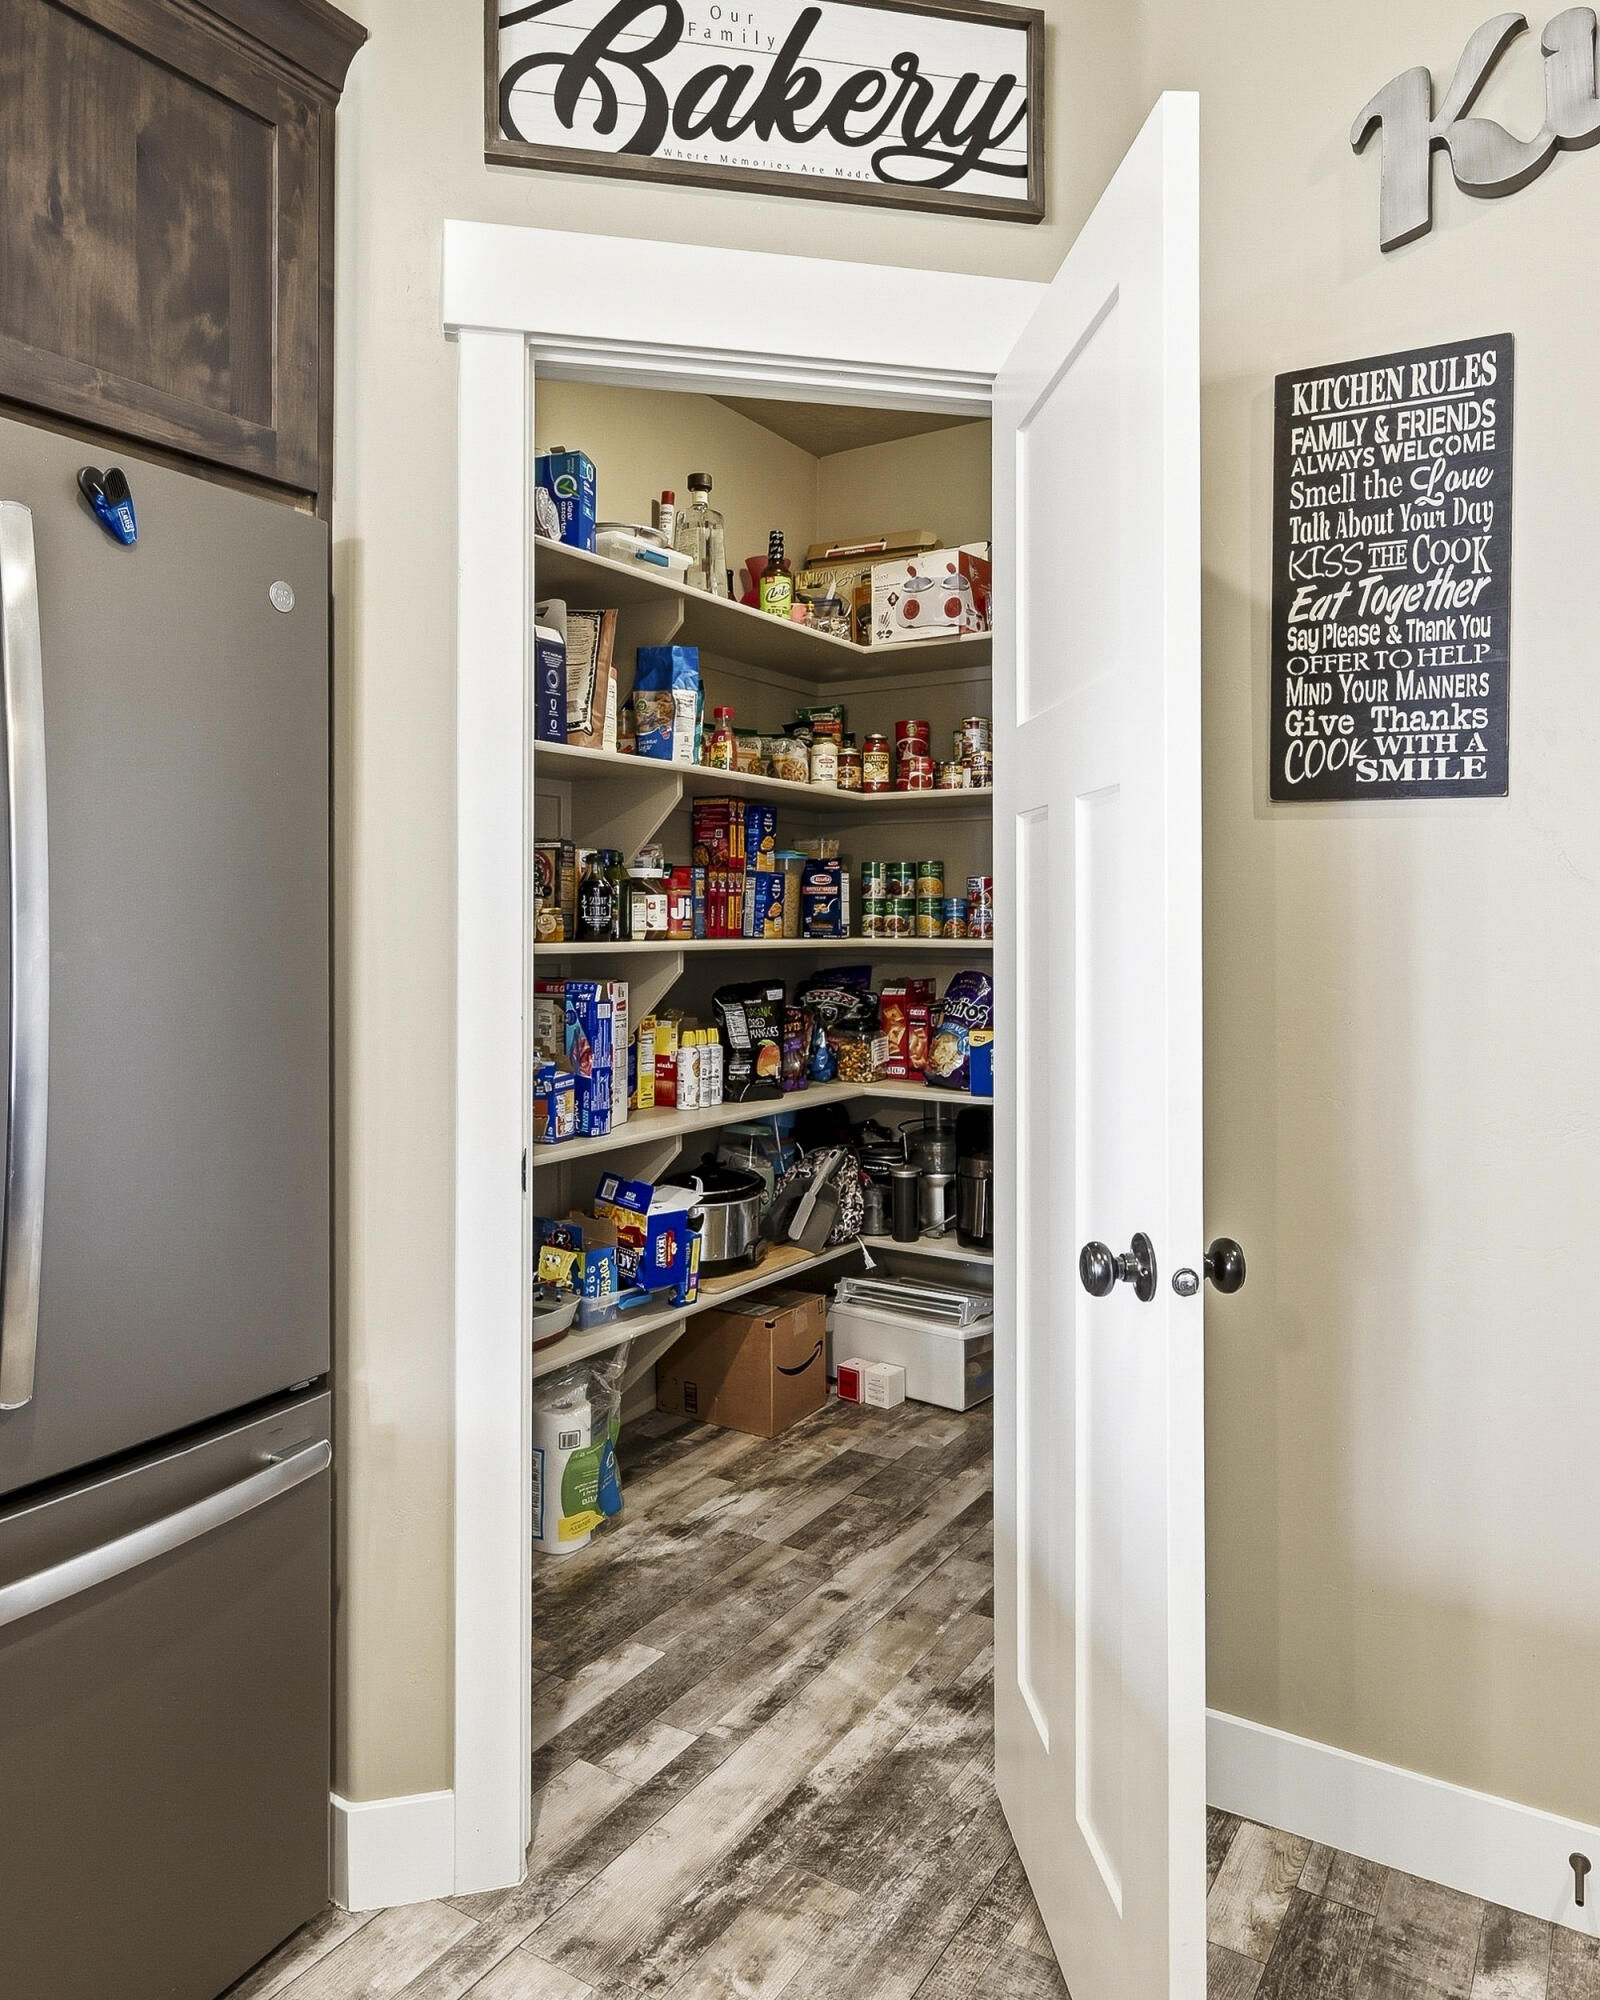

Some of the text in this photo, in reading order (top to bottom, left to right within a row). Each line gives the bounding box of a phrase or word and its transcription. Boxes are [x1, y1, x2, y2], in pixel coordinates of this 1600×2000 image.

[688, 21, 775, 51] Family
[709, 5, 754, 25] Our
[499, 0, 1028, 191] Bakery
[663, 148, 871, 179] Where Memories Are Made
[1291, 350, 1497, 417] KITCHEN RULES
[1291, 398, 1497, 456] FAMILY & FRIENDS
[1290, 430, 1496, 477] ALWAYS WELCOME
[1289, 457, 1495, 510] Smell the Love
[1289, 496, 1494, 544] Talk About Your Day
[1288, 534, 1493, 581] KISS THE COOK
[1287, 564, 1492, 624] Eat Together
[1287, 614, 1492, 654] Say Please & Thank You
[1286, 643, 1491, 676] OFFER TO HELP
[1284, 702, 1489, 738] Give Thanks
[1284, 732, 1489, 785] COOK WITH A
[1355, 755, 1488, 782] SMILE
[670, 897, 692, 920] Ji
[546, 984, 565, 993] MEG
